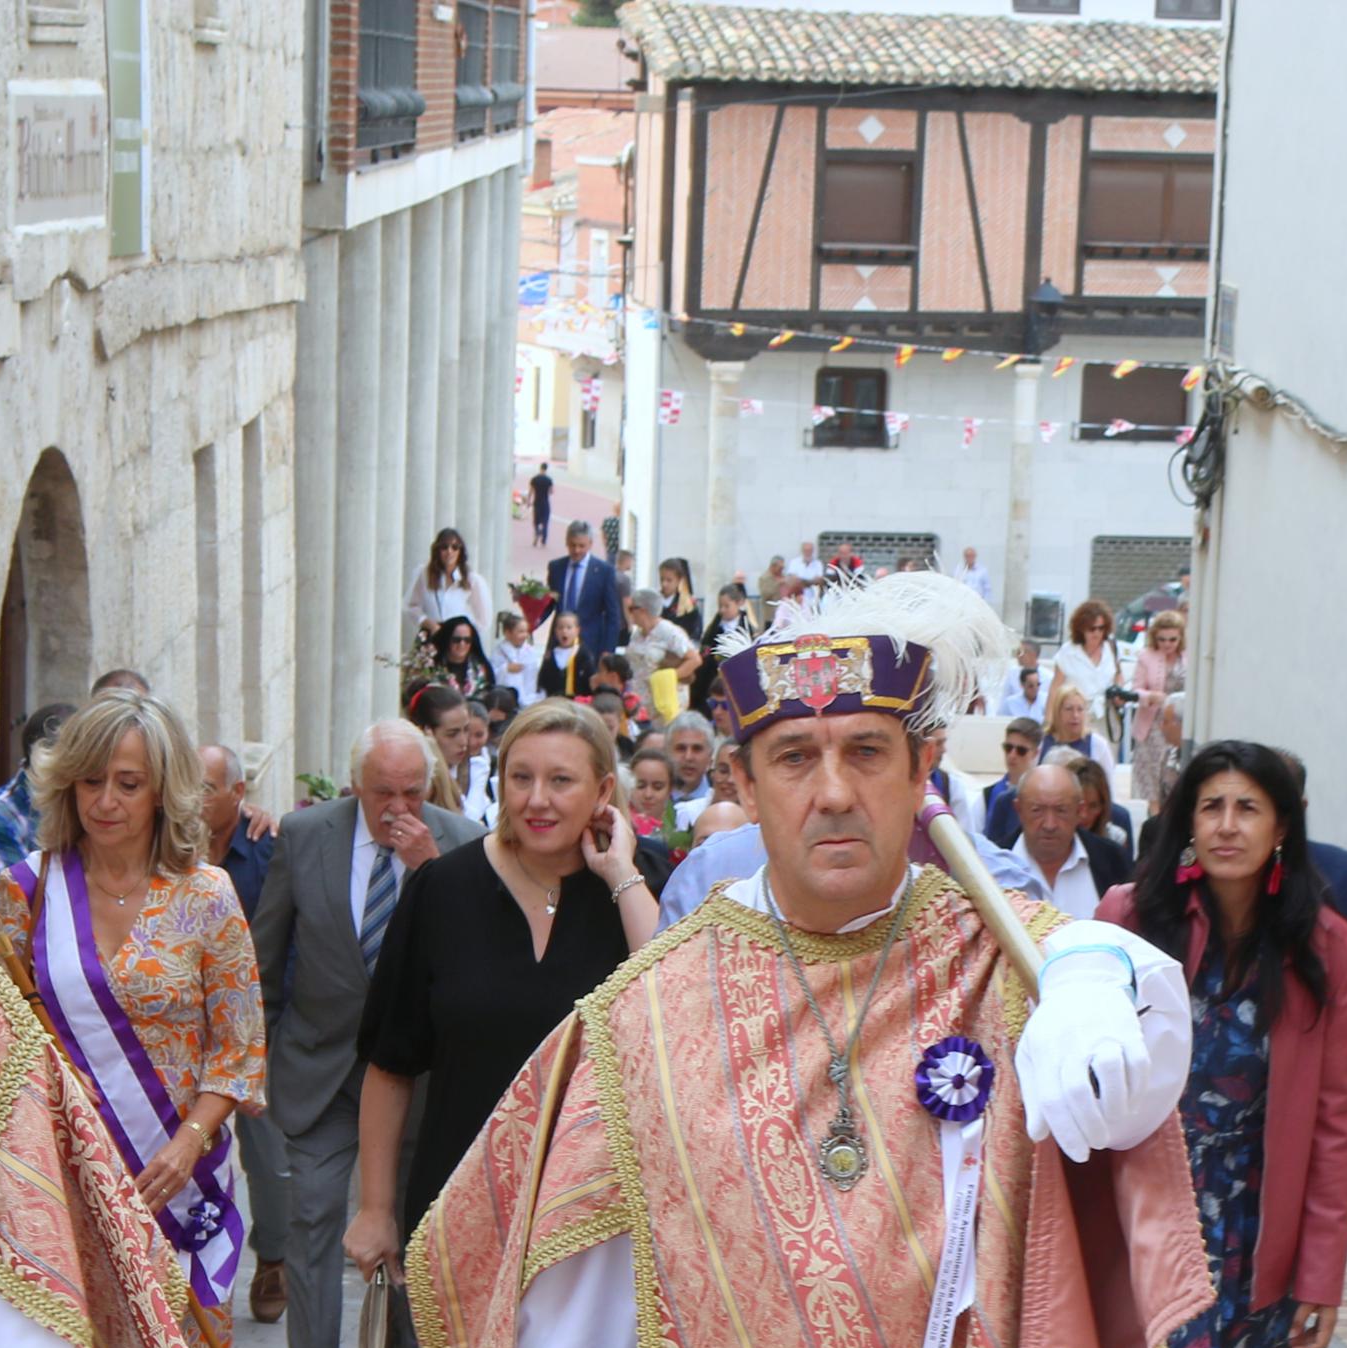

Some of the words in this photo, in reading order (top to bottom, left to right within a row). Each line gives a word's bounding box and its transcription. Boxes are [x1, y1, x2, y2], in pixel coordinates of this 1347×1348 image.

[951, 1220, 968, 1285] Ayuntamiento
[939, 1279, 949, 1290] de
[948, 1287, 956, 1299] de
